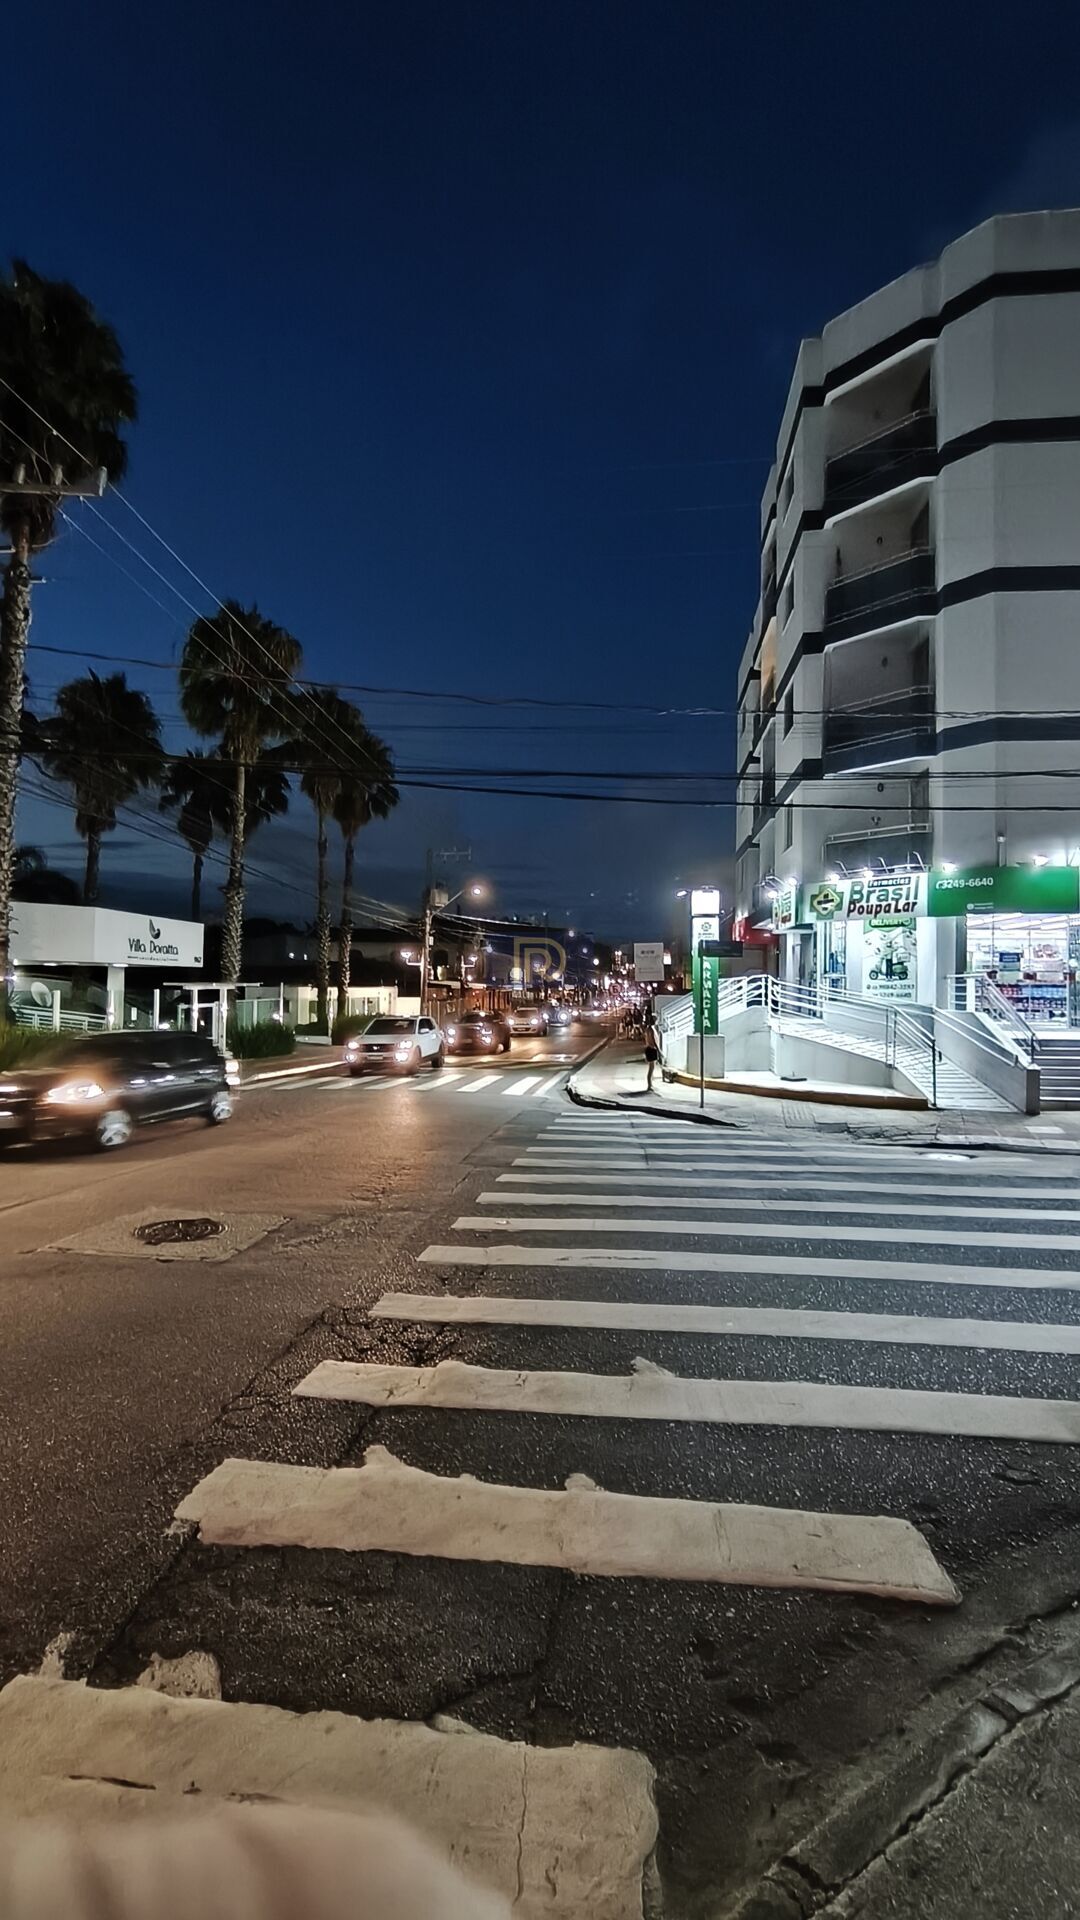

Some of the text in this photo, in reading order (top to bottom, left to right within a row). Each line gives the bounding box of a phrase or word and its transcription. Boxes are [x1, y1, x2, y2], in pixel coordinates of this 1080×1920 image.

[849, 876, 920, 904] Brasil
[941, 877, 994, 889] 3249-6640
[128, 938, 178, 955] Villa Doratta
[702, 957, 712, 1028] ARMACIA
